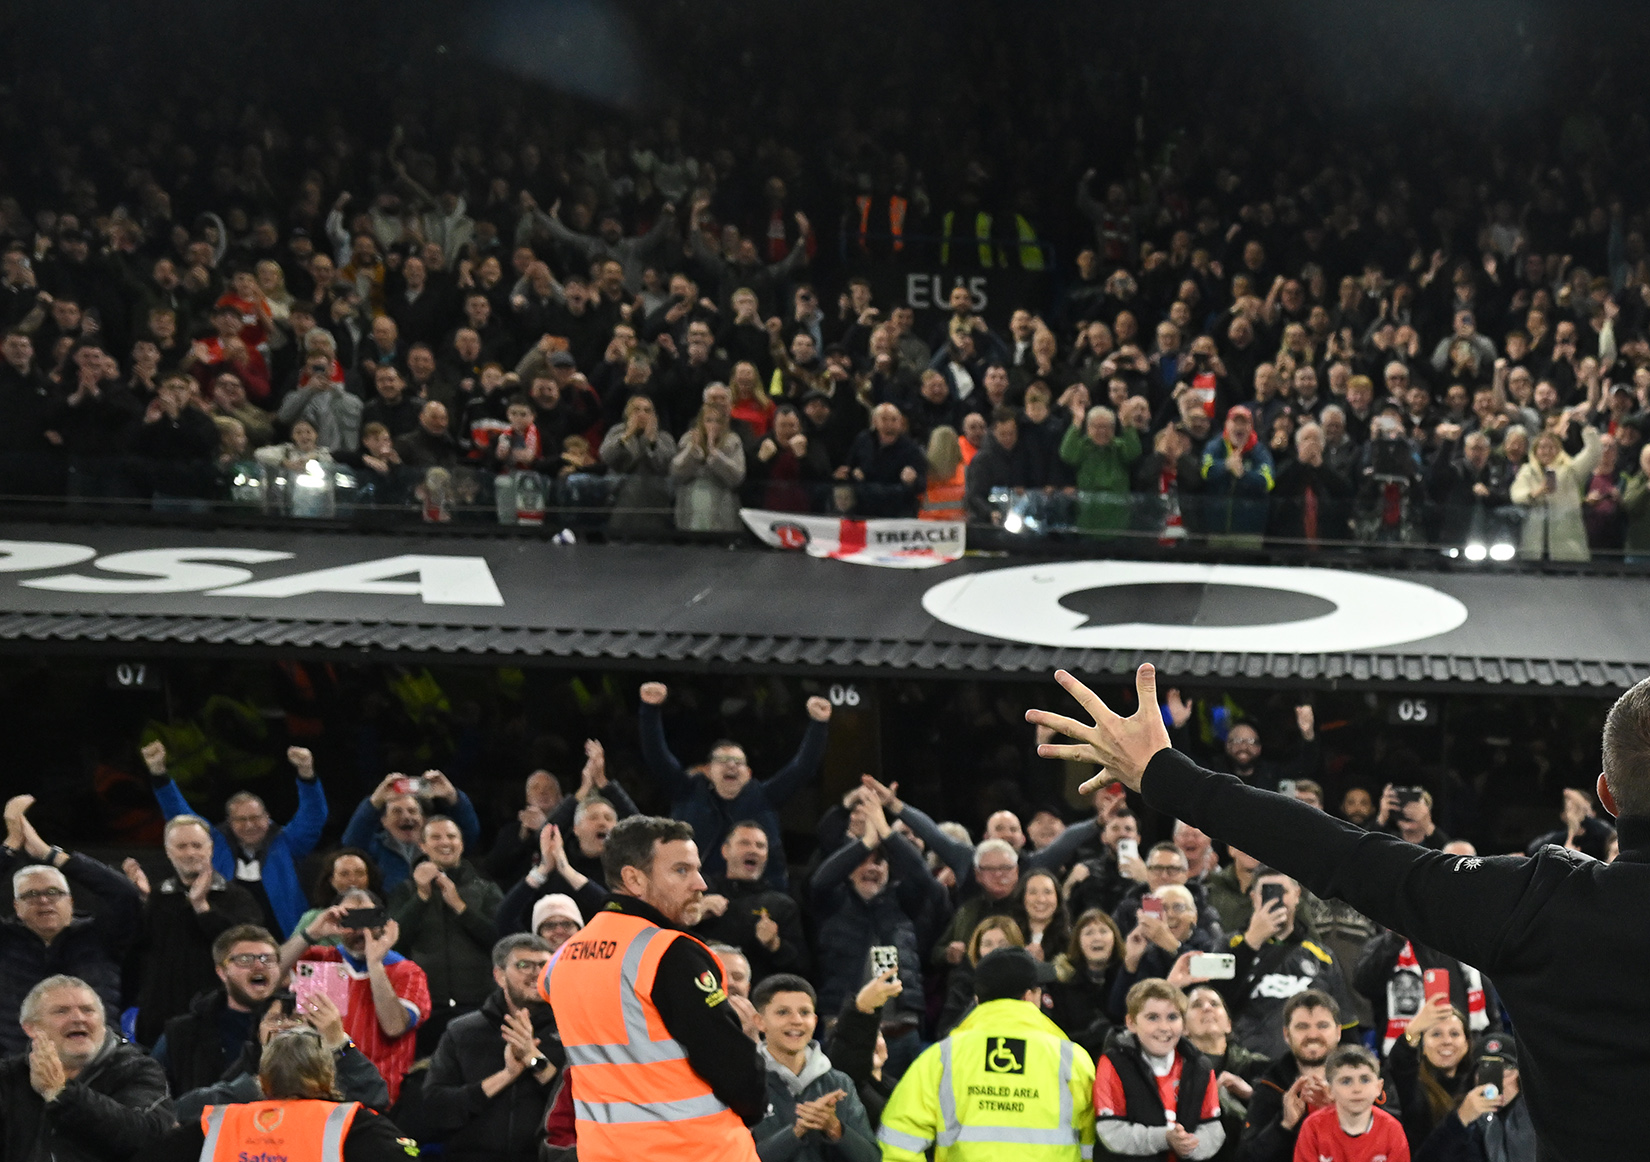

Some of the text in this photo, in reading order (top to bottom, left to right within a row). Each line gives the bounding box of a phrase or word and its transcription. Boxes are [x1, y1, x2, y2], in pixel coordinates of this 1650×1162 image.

[906, 273, 989, 312] EU5
[875, 526, 959, 545] TREACLE
[117, 663, 146, 686] 07
[829, 683, 861, 707] 06
[1398, 698, 1428, 721] 05
[1013, 1086, 1040, 1099] AREA
[978, 1099, 1025, 1113] STEWARD
